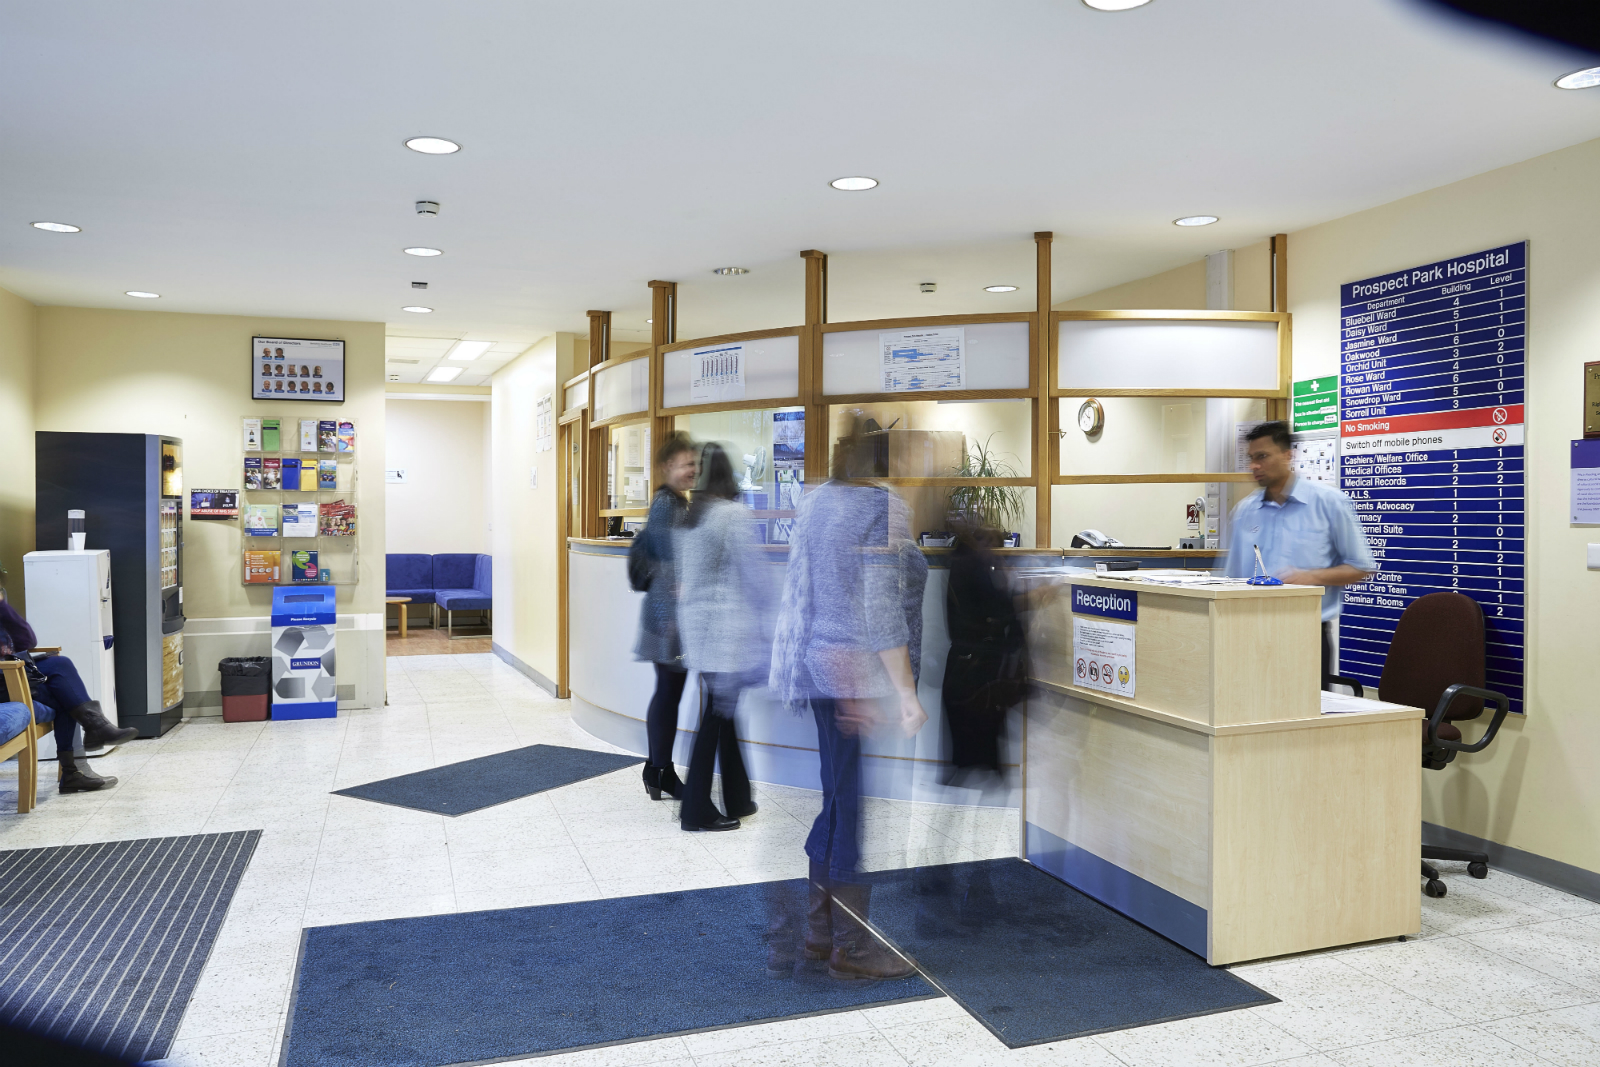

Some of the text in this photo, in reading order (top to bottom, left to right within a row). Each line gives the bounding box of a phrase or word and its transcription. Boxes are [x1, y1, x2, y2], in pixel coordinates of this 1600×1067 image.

[1352, 249, 1509, 298] Prospect Park Hospital
[1367, 274, 1512, 310] Department Building Level
[1346, 289, 1503, 326] Bluebell Ward 4 1
[1346, 302, 1503, 338] Daisy Ward 5 1
[1345, 315, 1503, 350] Jasmine Ward 1 1
[1345, 328, 1504, 361] Oakwood 6 0
[1346, 342, 1504, 372] Orchid Unit 3 2
[1346, 355, 1504, 383] Rose Ward 4 0
[1346, 368, 1503, 395] Rowan Ward 6 1
[1346, 382, 1504, 407] Snowdrop Ward 5 0
[1346, 395, 1503, 418] Sorrell Unit 3 1
[1357, 422, 1389, 432] Smoking
[1346, 436, 1442, 450] Switch off mobile phones
[1344, 448, 1502, 464] Cashiers/Welfare Office 1 1
[1345, 461, 1504, 475] Medical Offices 2 2
[1345, 475, 1504, 487] Medical Records 2 2
[1453, 489, 1458, 498] 1
[1498, 488, 1502, 497] 1
[1377, 501, 1414, 511] Advocacy
[1453, 502, 1458, 510] 1
[1498, 501, 1502, 510] 1
[1452, 514, 1458, 523] 2
[1498, 514, 1502, 524] 1
[1453, 527, 1458, 536] 1
[1497, 527, 1504, 537] 0
[1452, 540, 1458, 549] 2
[1498, 541, 1502, 550] 1
[1453, 552, 1458, 562] 1
[1497, 554, 1504, 563] 2
[1452, 565, 1502, 576] 3 1
[1377, 573, 1402, 582] Centre
[1452, 578, 1458, 587] 2
[1498, 580, 1502, 590] 1
[1076, 590, 1131, 612] Reception
[1369, 584, 1386, 592] Care
[1388, 586, 1407, 594] Team
[1498, 594, 1502, 603] 1
[1344, 594, 1504, 616] Seminar Rooms 2
